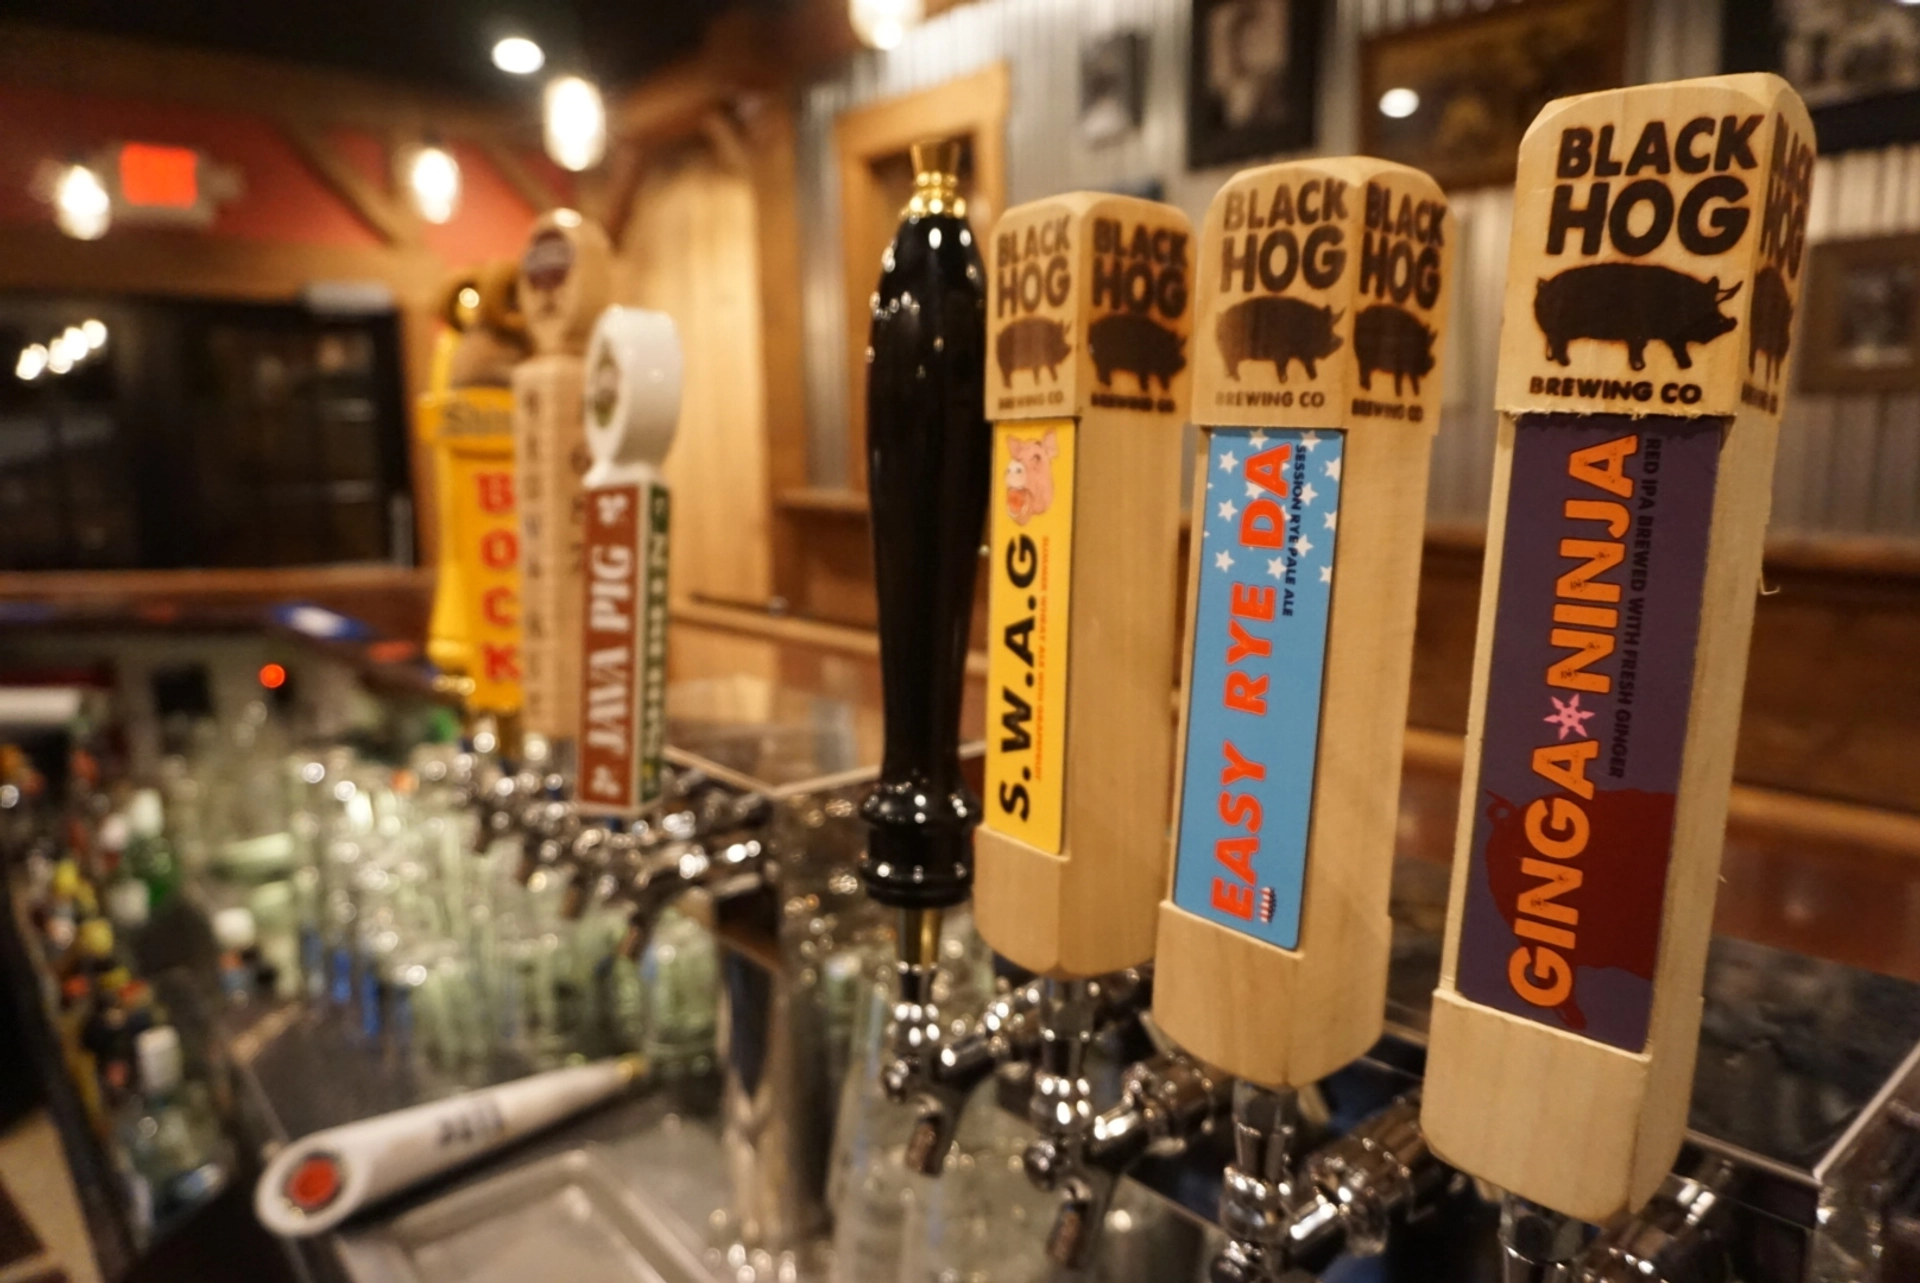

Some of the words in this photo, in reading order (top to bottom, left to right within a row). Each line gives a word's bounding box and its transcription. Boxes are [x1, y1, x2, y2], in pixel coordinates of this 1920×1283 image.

[1556, 114, 1765, 178] BLACK
[1773, 112, 1815, 198] BLACK
[1223, 180, 1350, 230] BLACK
[1364, 182, 1446, 247] BLACK
[1546, 175, 1750, 257] HOG
[1760, 172, 1804, 279] HOG
[997, 215, 1071, 267] BLACK
[1093, 218, 1188, 266] BLACK
[1220, 225, 1346, 293] HOG
[1359, 231, 1442, 309] HOG
[997, 257, 1071, 319] HOG
[1093, 256, 1187, 318] HOG
[998, 394, 1045, 410] BREWING
[1215, 390, 1294, 407] BREWING
[1299, 391, 1325, 407] CO
[1352, 398, 1400, 420] BREWING
[1529, 376, 1652, 403] BREWING
[1660, 382, 1703, 404] CO
[1291, 444, 1306, 511] SESSION
[1643, 437, 1661, 475] RED
[1239, 442, 1292, 550] DA
[1638, 479, 1657, 511] IPA
[1289, 513, 1301, 544] RYE
[1630, 515, 1653, 592] BREWED
[477, 472, 522, 683] BOCK
[591, 544, 633, 634] PIG
[1041, 535, 1050, 592] SUMMER
[1285, 546, 1299, 586] PALE
[1546, 434, 1638, 694] NINJA
[1282, 588, 1295, 617] ALE
[1624, 597, 1645, 646] WITH
[1000, 533, 1037, 822] S.W.A.G
[1038, 645, 1046, 668] ALE
[1224, 582, 1276, 716] RYE
[1618, 649, 1637, 705] FRESH
[587, 645, 631, 754] JAVA
[1609, 709, 1631, 779] GINGER
[1211, 740, 1267, 922] EASY
[1508, 740, 1600, 1007] GINGA
